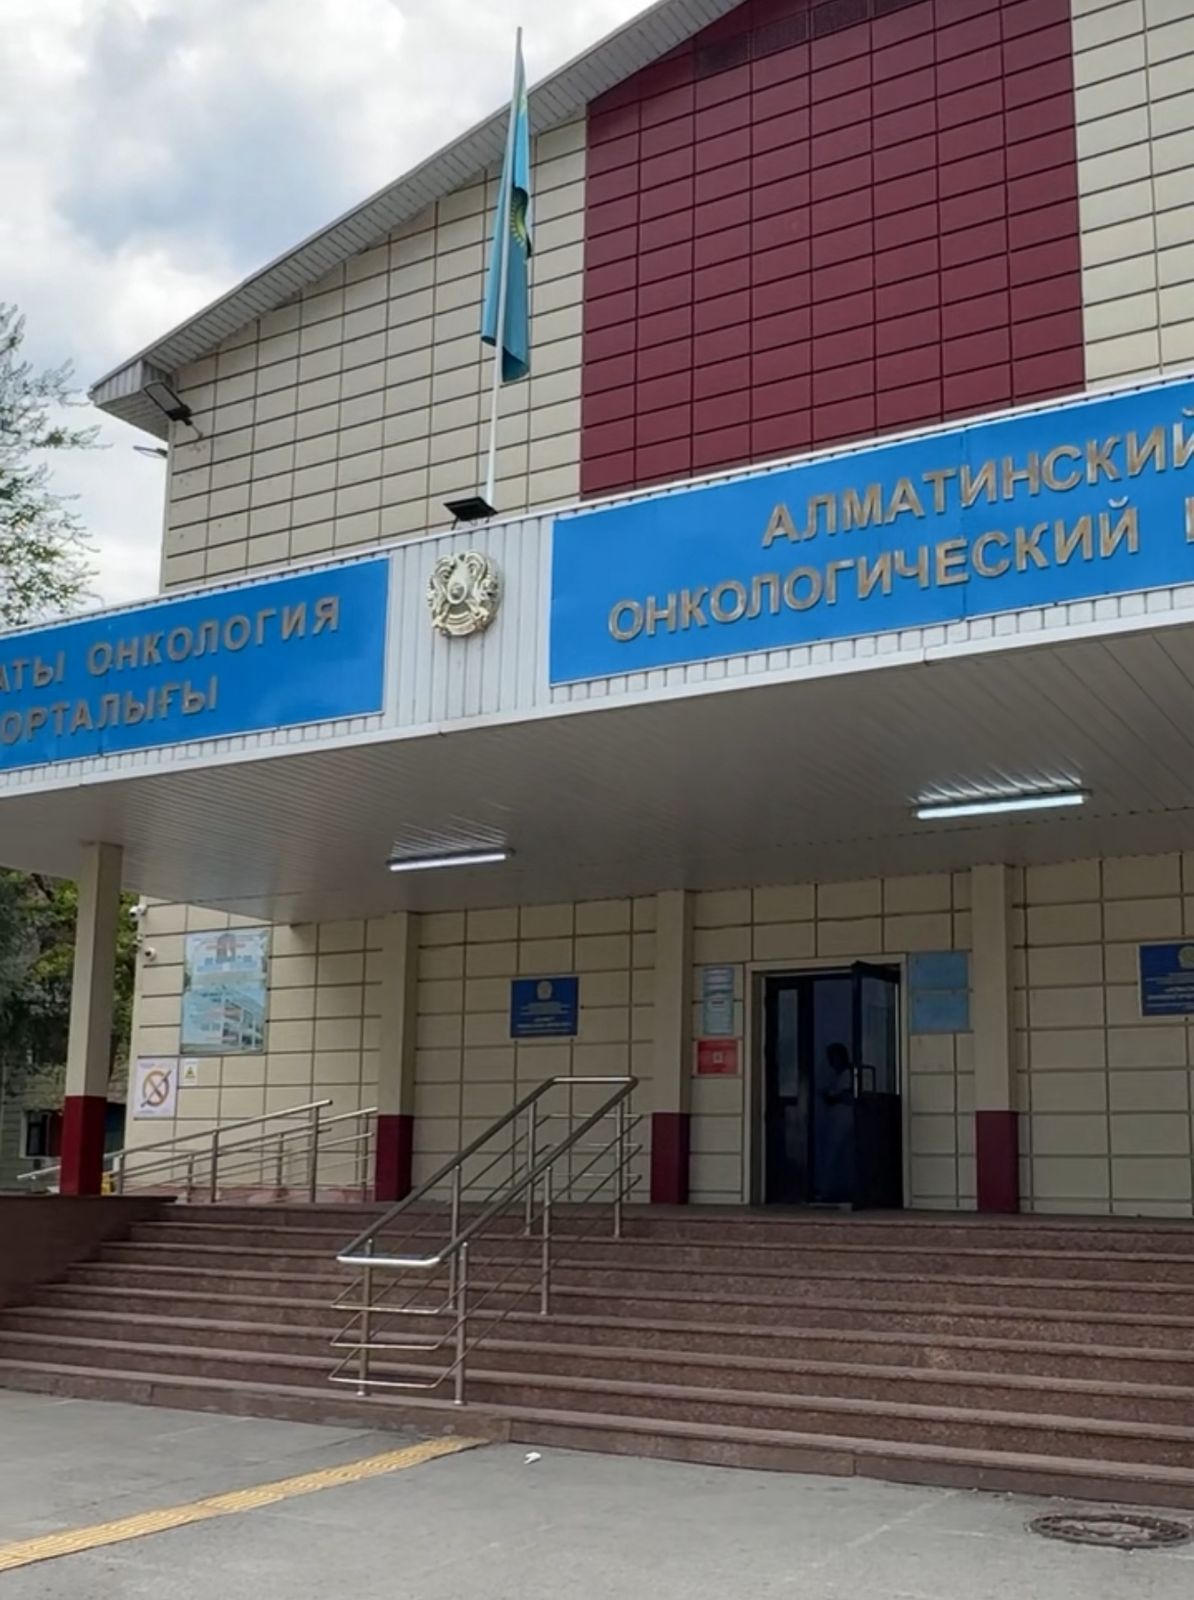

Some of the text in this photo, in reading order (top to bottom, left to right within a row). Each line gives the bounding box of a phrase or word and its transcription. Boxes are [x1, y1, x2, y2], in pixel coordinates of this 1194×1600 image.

[762, 408, 1194, 547] АЛМАТИНСКИЙ
[608, 496, 1139, 641] ОНКОЛОГИЧЕСКИЙ
[87, 597, 339, 677] ОНКОЛОГИЯ
[1, 675, 217, 745] ОРТАЛЫҒЫ
